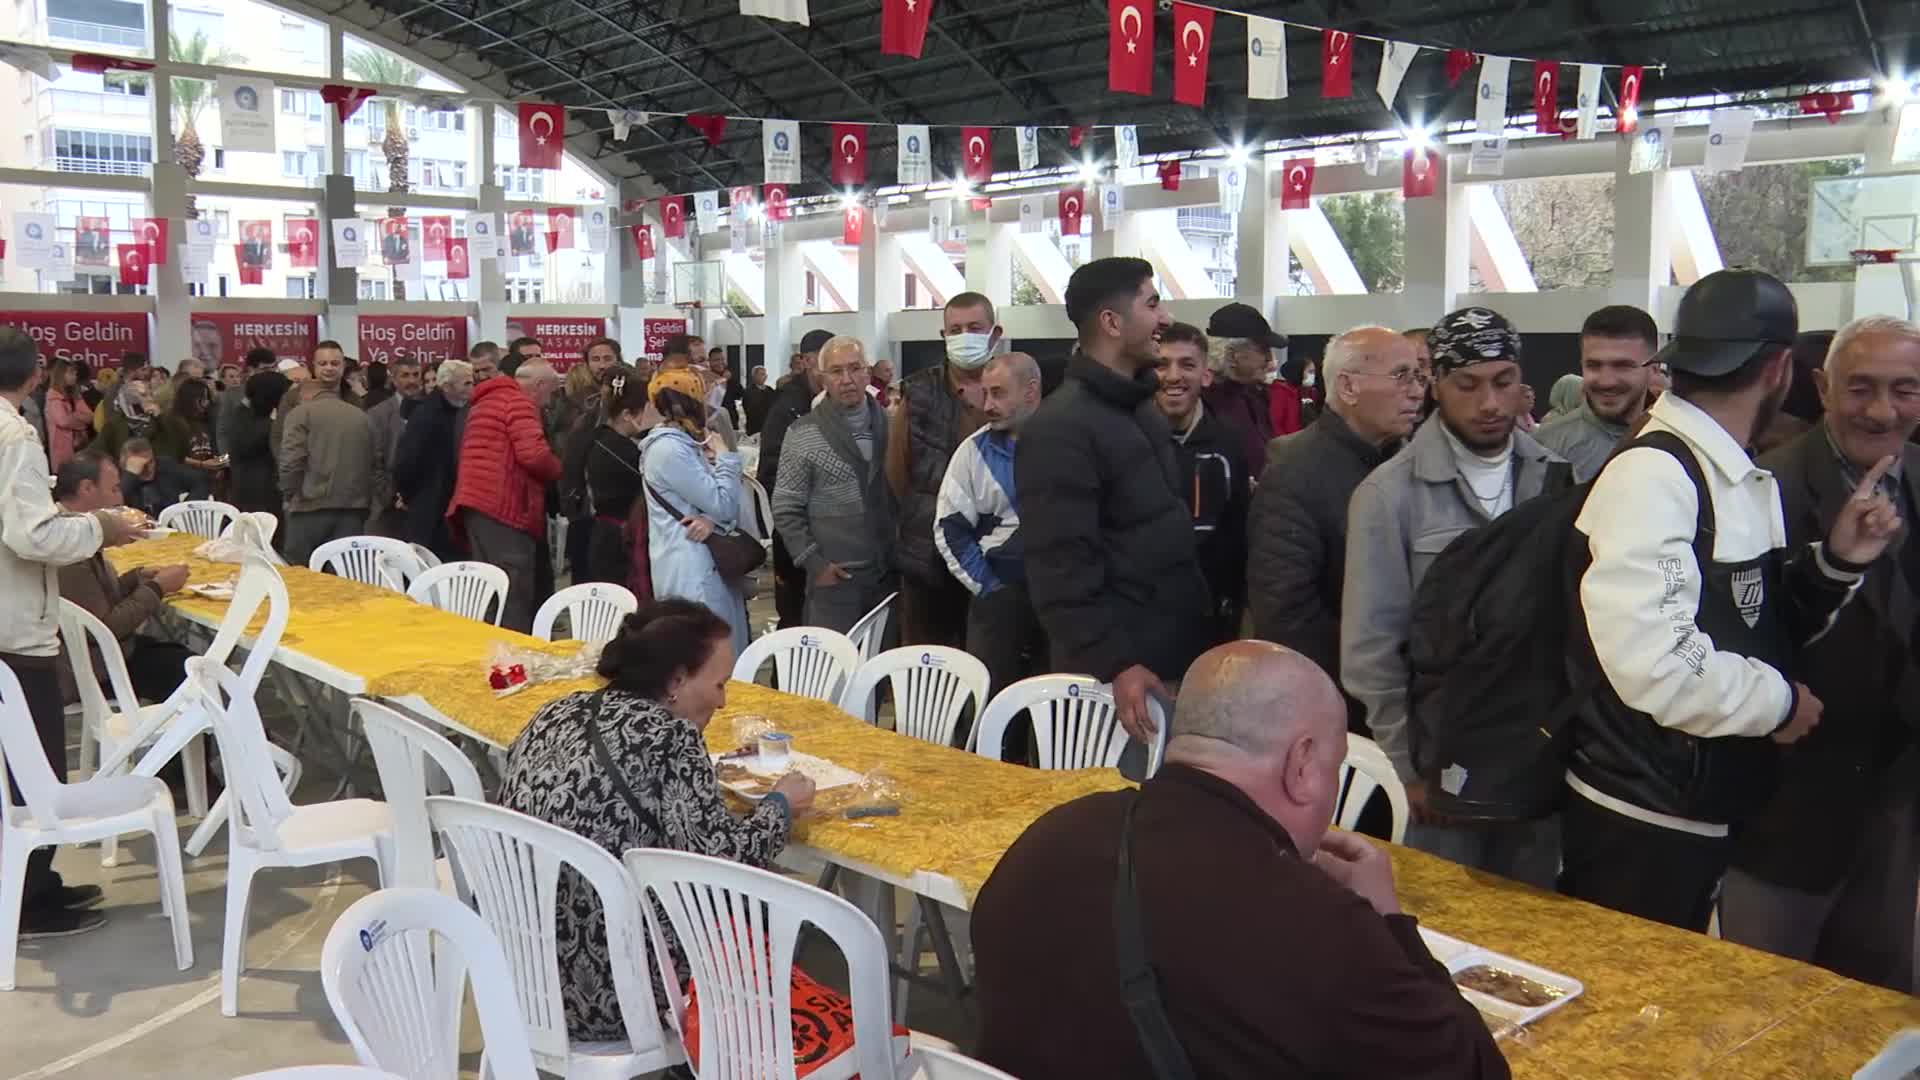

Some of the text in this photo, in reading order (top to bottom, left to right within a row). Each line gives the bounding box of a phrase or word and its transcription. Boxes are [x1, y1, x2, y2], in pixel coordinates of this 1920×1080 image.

[64, 321, 133, 341] Geldin
[234, 322, 309, 336] HERKESİN
[361, 323, 455, 346] Hoş Geldin
[536, 323, 597, 336] HERKESİN
[367, 347, 389, 365] Ya
